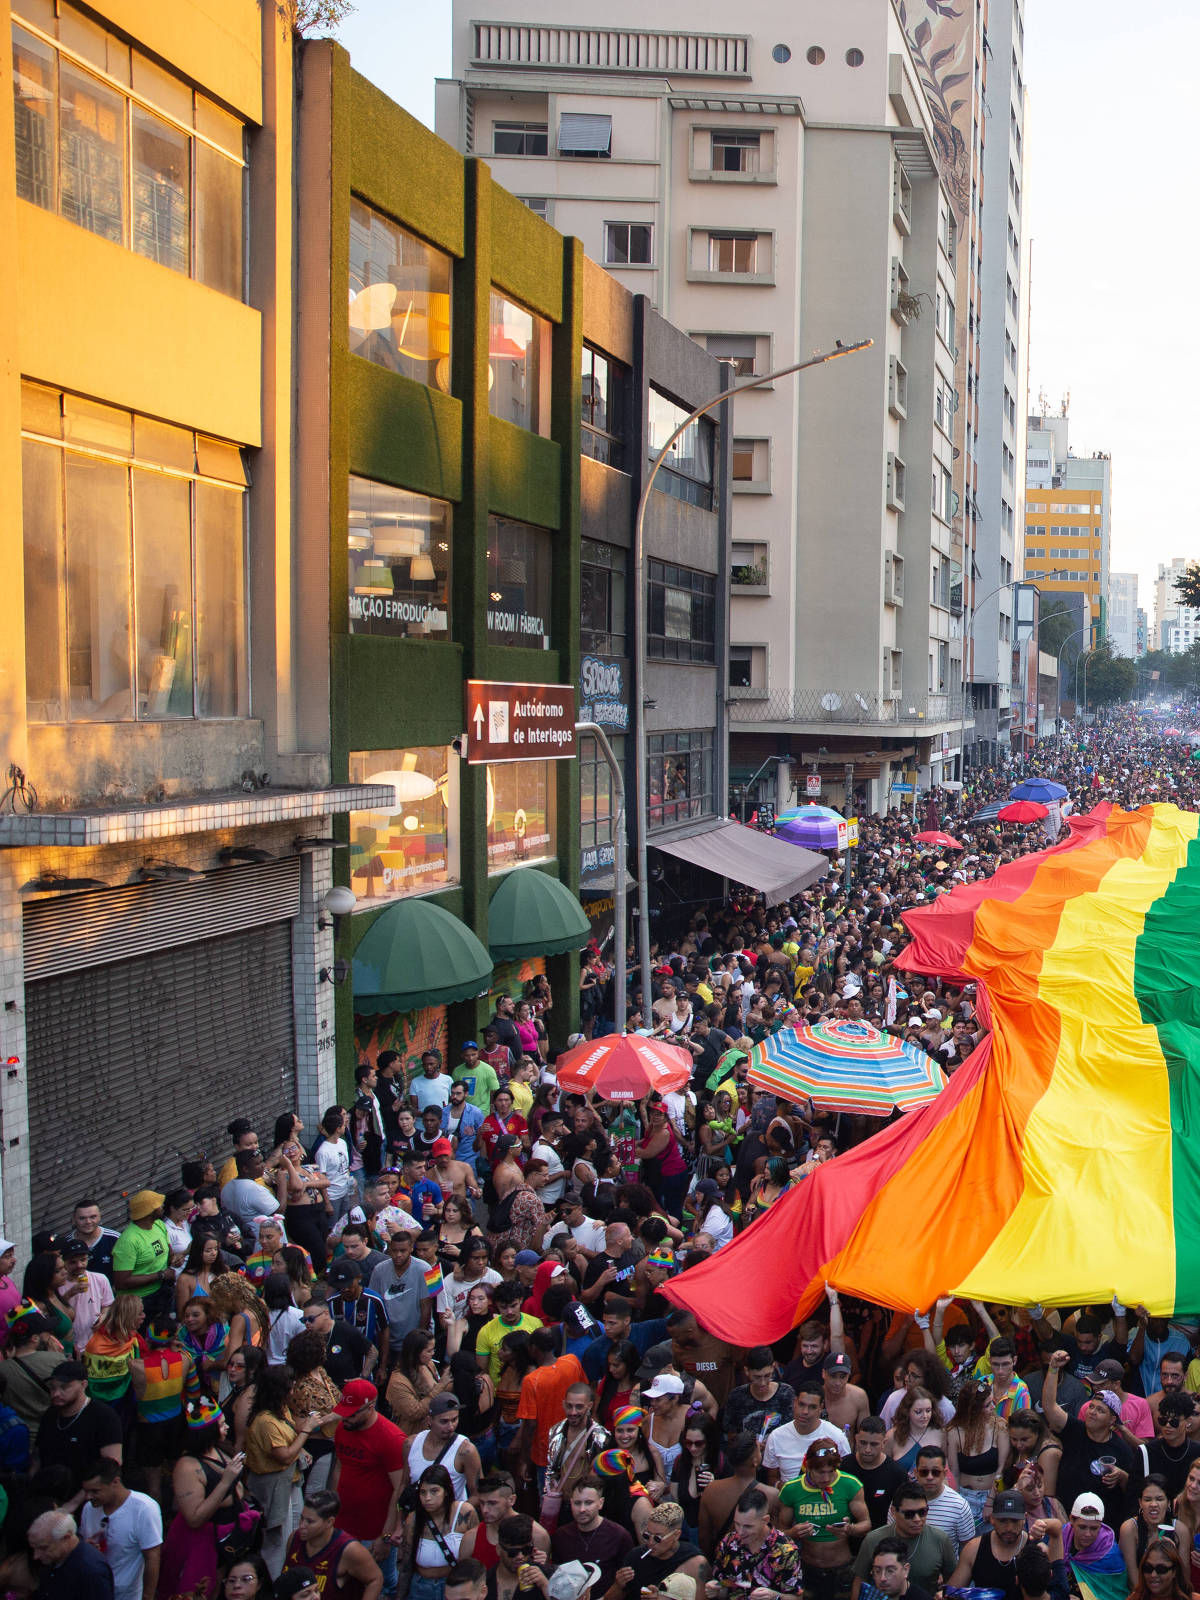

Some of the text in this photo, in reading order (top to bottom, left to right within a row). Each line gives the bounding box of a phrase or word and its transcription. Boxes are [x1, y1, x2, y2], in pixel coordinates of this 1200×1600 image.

[349, 594, 384, 621] RIAÇÃO
[385, 600, 391, 618] E
[495, 612, 515, 633] ROOM
[520, 611, 544, 635] FÁBRICA
[514, 698, 564, 717] Autódromo
[513, 728, 572, 747] de Interlagos
[576, 1046, 611, 1076] BRAHMA
[638, 1046, 671, 1076] BRAHMA
[610, 1091, 634, 1099] BRAHMA
[696, 1362, 718, 1372] DIESEL
[799, 1503, 838, 1516] BRASIL
